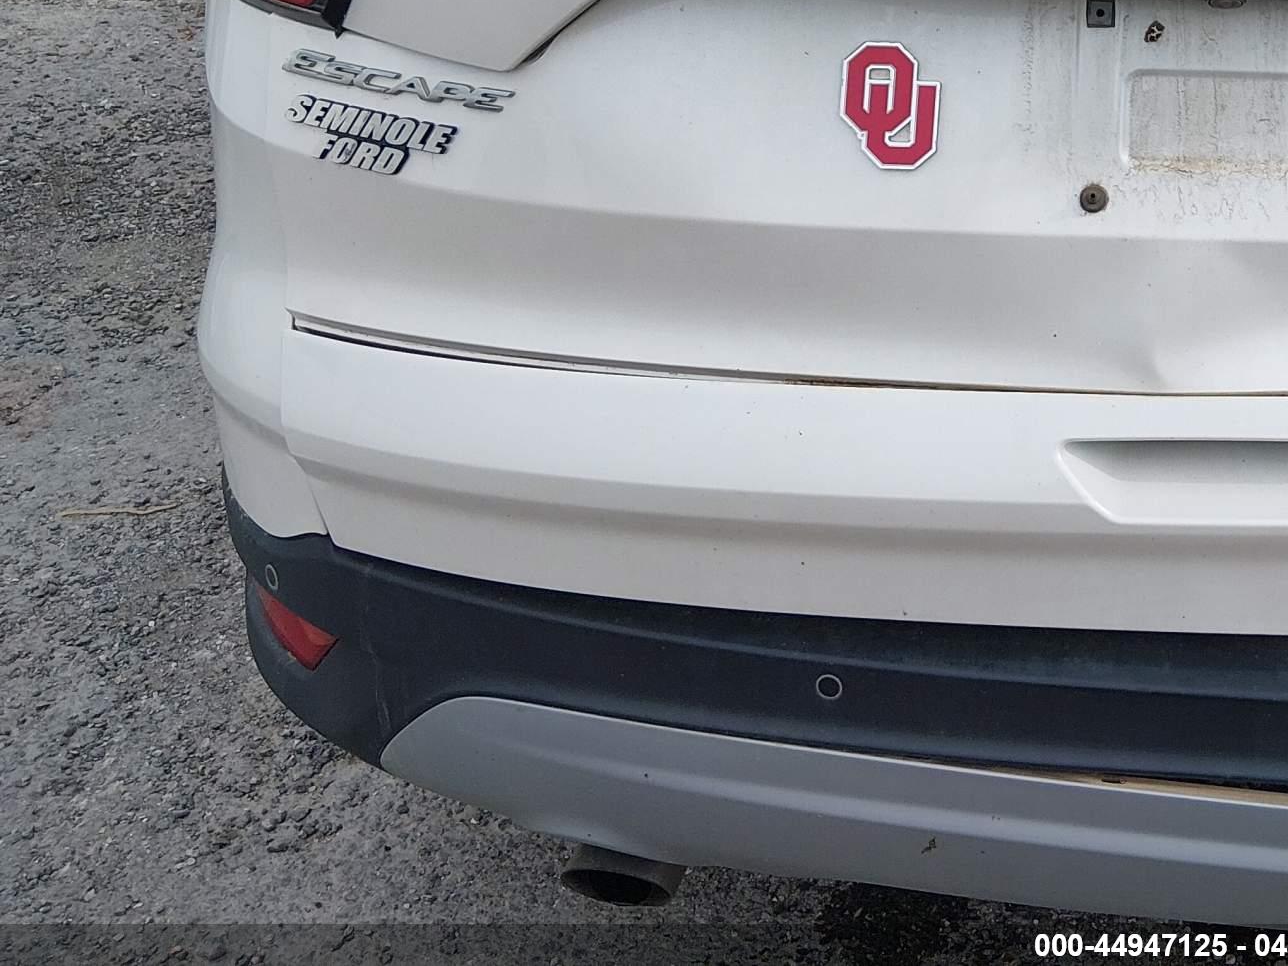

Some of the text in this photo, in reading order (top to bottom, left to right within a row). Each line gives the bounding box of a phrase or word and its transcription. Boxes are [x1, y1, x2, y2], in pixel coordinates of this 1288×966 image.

[281, 48, 516, 113] ESCAPE
[840, 41, 941, 169] OU
[284, 94, 459, 155] SEMINOLE
[312, 131, 411, 176] FORD
